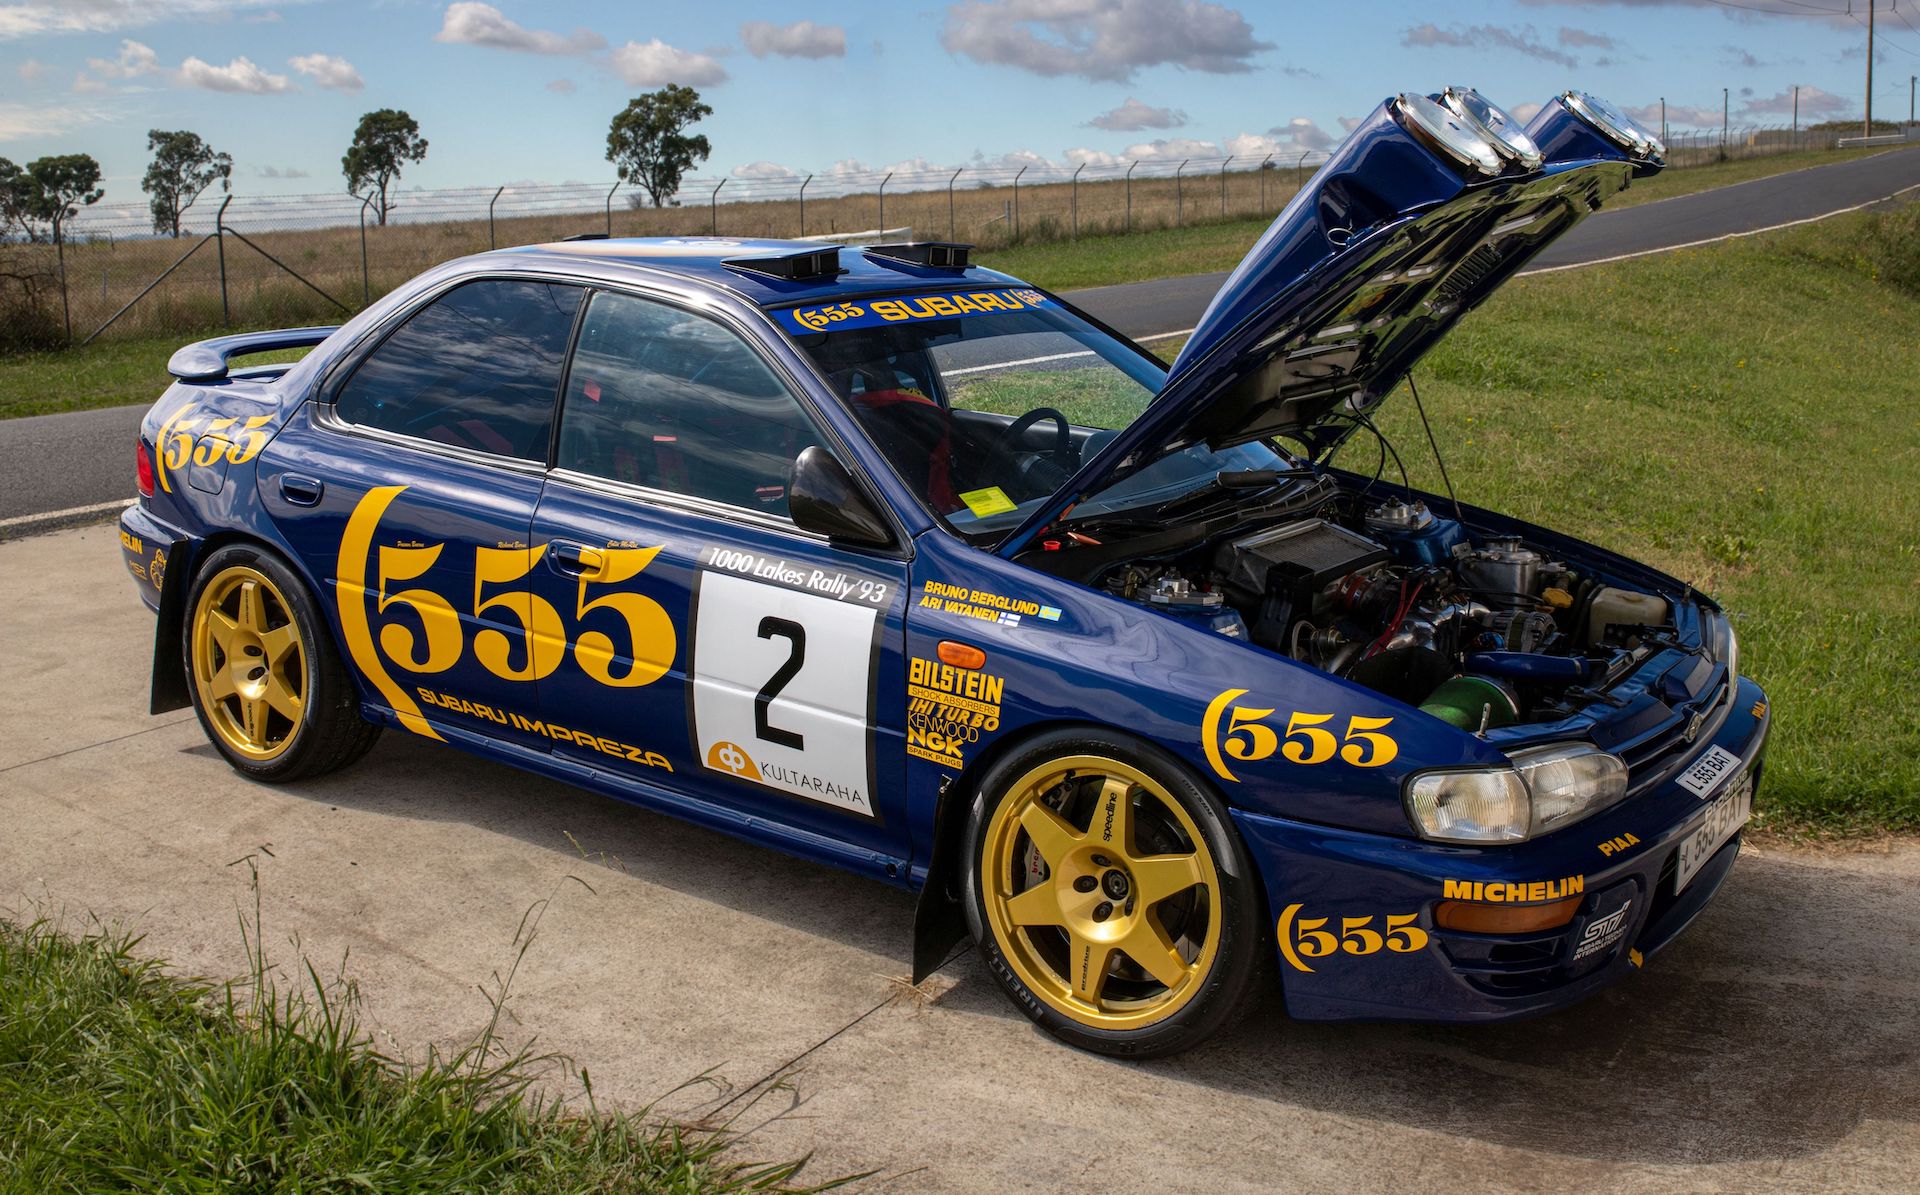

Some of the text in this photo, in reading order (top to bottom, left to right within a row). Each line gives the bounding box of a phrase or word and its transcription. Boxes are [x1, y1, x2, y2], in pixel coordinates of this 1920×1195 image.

[870, 288, 1024, 321] SUBARU
[708, 547, 754, 573] 1000
[753, 558, 805, 585] Lakes
[919, 595, 1000, 623] ARI VATANEN
[924, 580, 1039, 616] BRUNO BERGLUND
[755, 616, 806, 751] 2
[909, 657, 1004, 704] BILSTEIN
[908, 698, 1000, 731] IHI TURBO
[912, 688, 996, 715] SHOCK ABSORBERS
[417, 687, 674, 773] SUBARU IMPREZA
[907, 726, 964, 758] NGK
[908, 711, 979, 743] KENWOOD
[908, 746, 962, 768] SPARK PLUGS
[1706, 751, 1731, 771] BAT
[761, 762, 864, 805] KULTARAHA
[1686, 780, 1704, 791] L
[1693, 766, 1717, 784] 555
[1103, 792, 1117, 842] speedline
[1598, 832, 1640, 857] PIAA
[1443, 874, 1584, 902] MICHELIN
